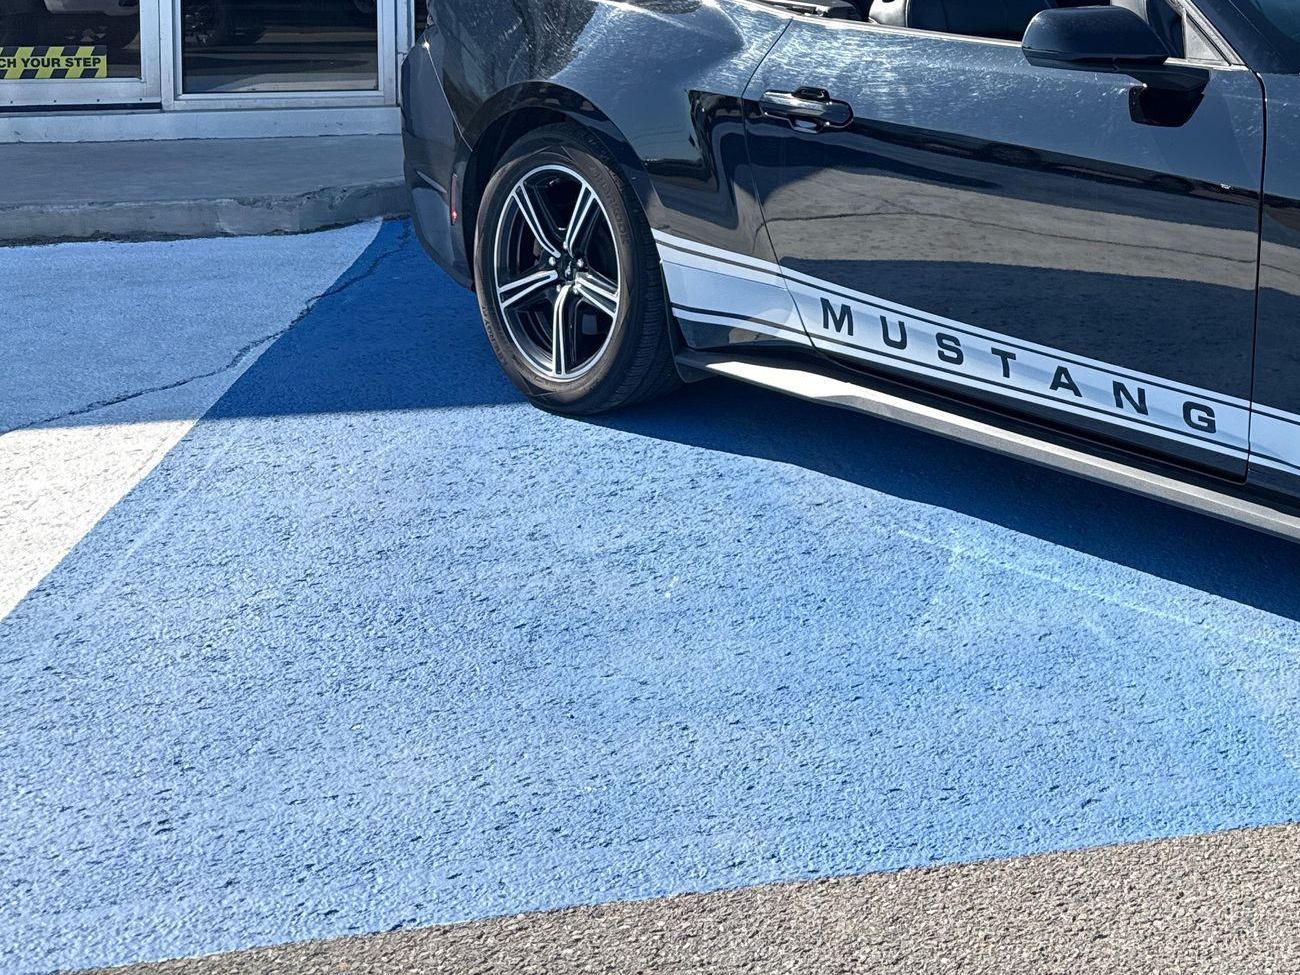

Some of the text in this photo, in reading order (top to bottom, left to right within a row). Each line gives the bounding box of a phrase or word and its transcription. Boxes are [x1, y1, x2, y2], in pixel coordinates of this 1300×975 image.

[21, 57, 61, 68] YOUR
[64, 57, 102, 67] STEP
[819, 296, 1217, 435] MUSTANG
